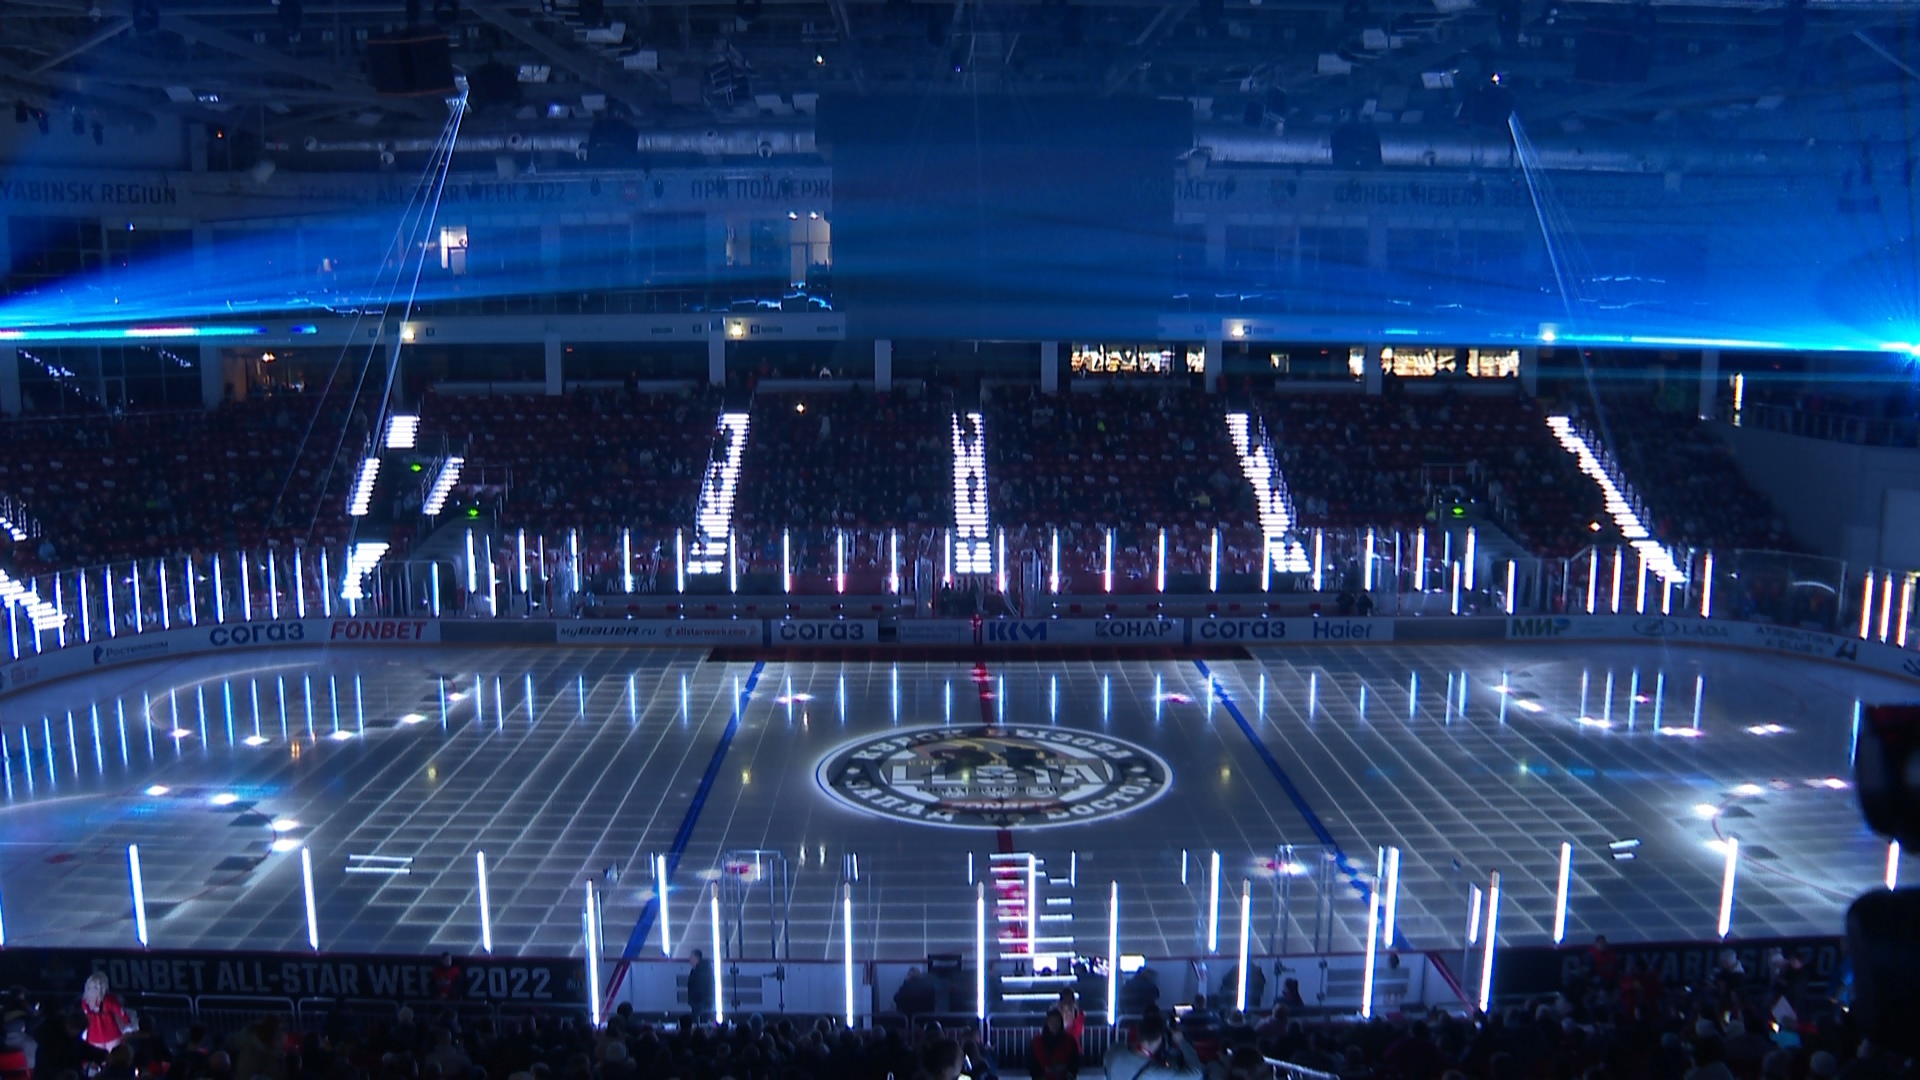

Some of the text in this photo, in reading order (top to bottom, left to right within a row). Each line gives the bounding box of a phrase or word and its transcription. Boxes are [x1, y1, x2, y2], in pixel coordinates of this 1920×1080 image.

[330, 620, 428, 641] FONBET
[1095, 620, 1173, 638] КОНАР
[1312, 619, 1374, 640] Haier
[1511, 617, 1572, 637] МИР
[1682, 624, 1729, 638] LADA
[91, 958, 206, 991] FONBET
[216, 961, 361, 996] ALL-STAR
[367, 963, 434, 997] WEE
[466, 966, 553, 999] 2022
